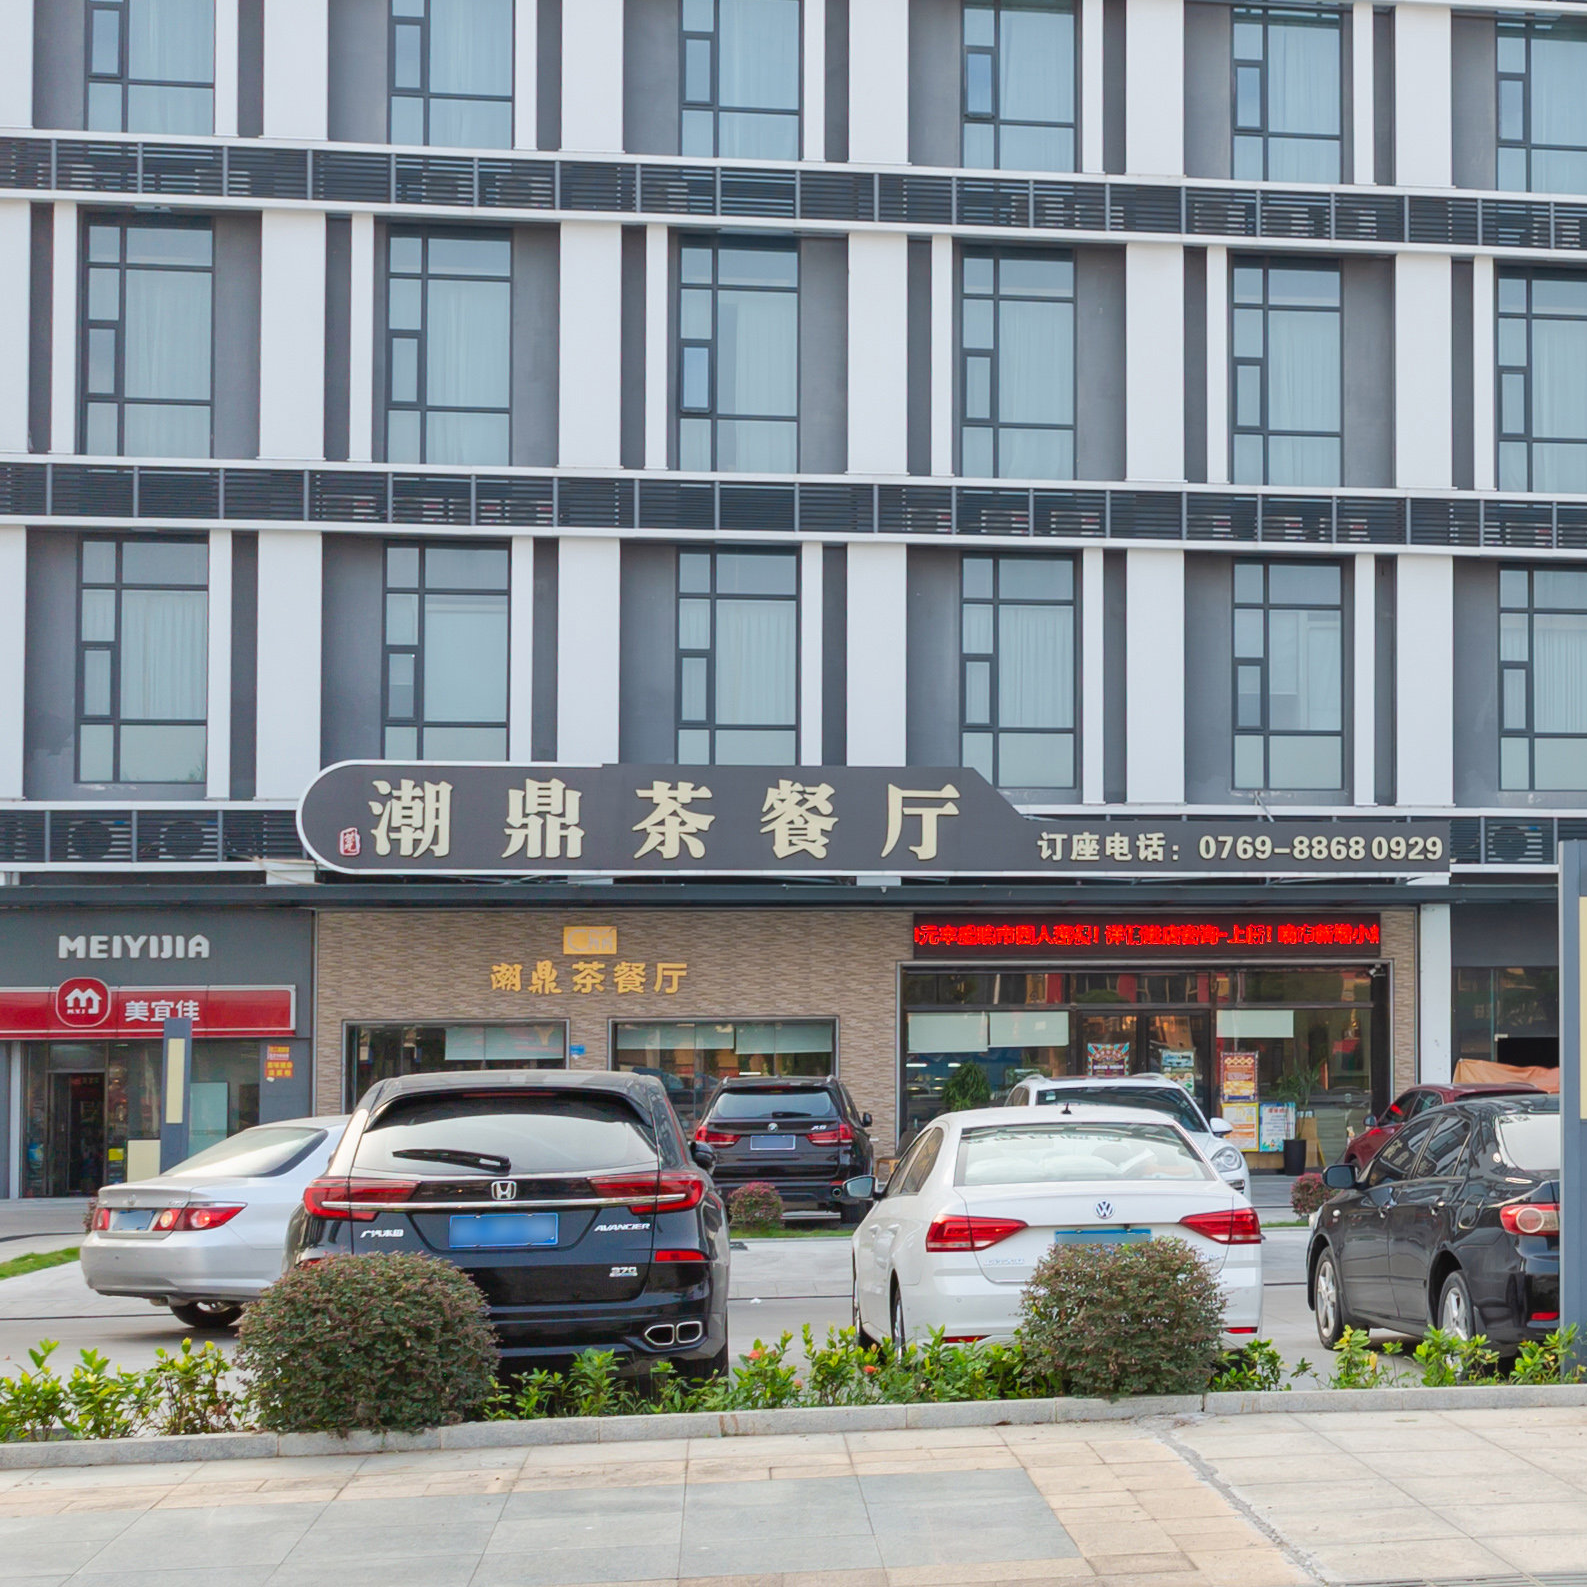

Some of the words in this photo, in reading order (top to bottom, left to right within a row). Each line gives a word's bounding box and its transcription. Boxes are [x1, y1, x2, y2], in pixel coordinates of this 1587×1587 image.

[368, 777, 962, 861] 潮鼎茶餐厅
[1037, 831, 1181, 862] 订座电话：
[58, 934, 210, 959] MEIYIJIA
[489, 959, 688, 995] 潮鼎茶餐厅
[124, 999, 200, 1022] 美宜佳
